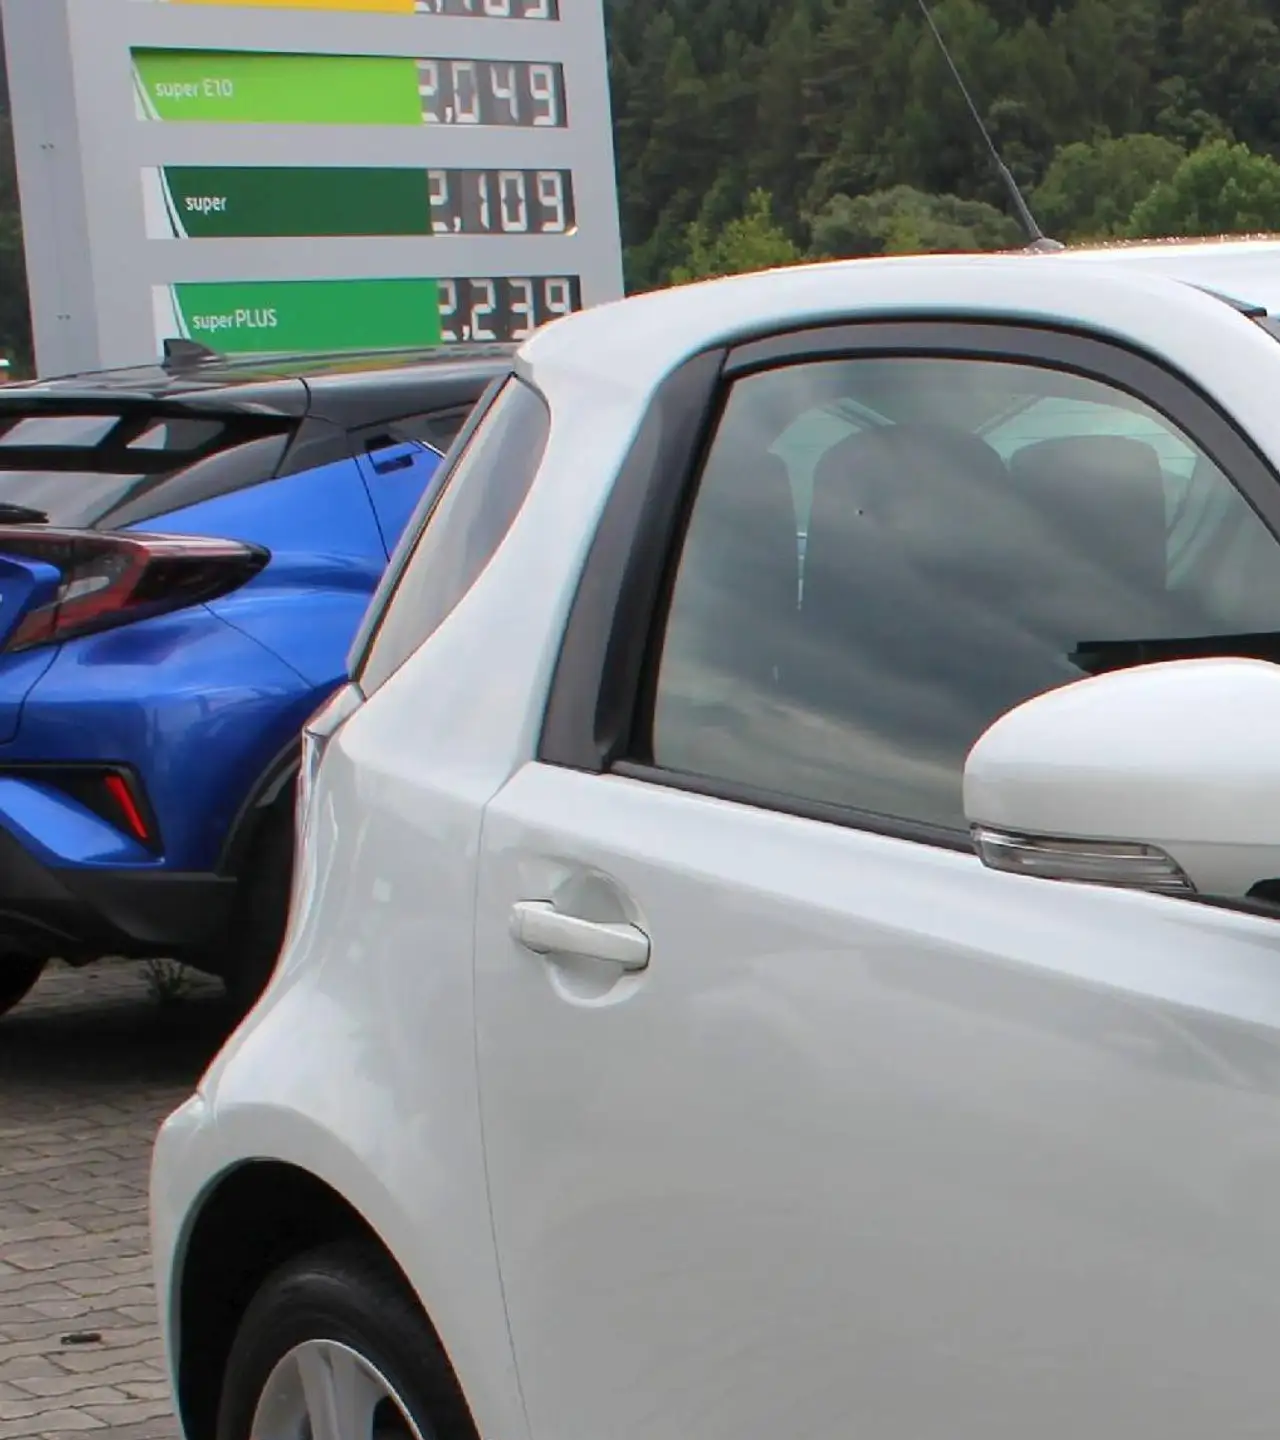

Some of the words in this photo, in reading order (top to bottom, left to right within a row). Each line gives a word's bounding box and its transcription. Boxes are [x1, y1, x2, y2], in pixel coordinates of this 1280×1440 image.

[155, 82, 199, 101] super
[203, 78, 234, 98] E10
[415, 60, 557, 127] 2,049
[184, 196, 227, 215] super
[427, 169, 566, 233] 2,109
[437, 277, 573, 342] 2,239
